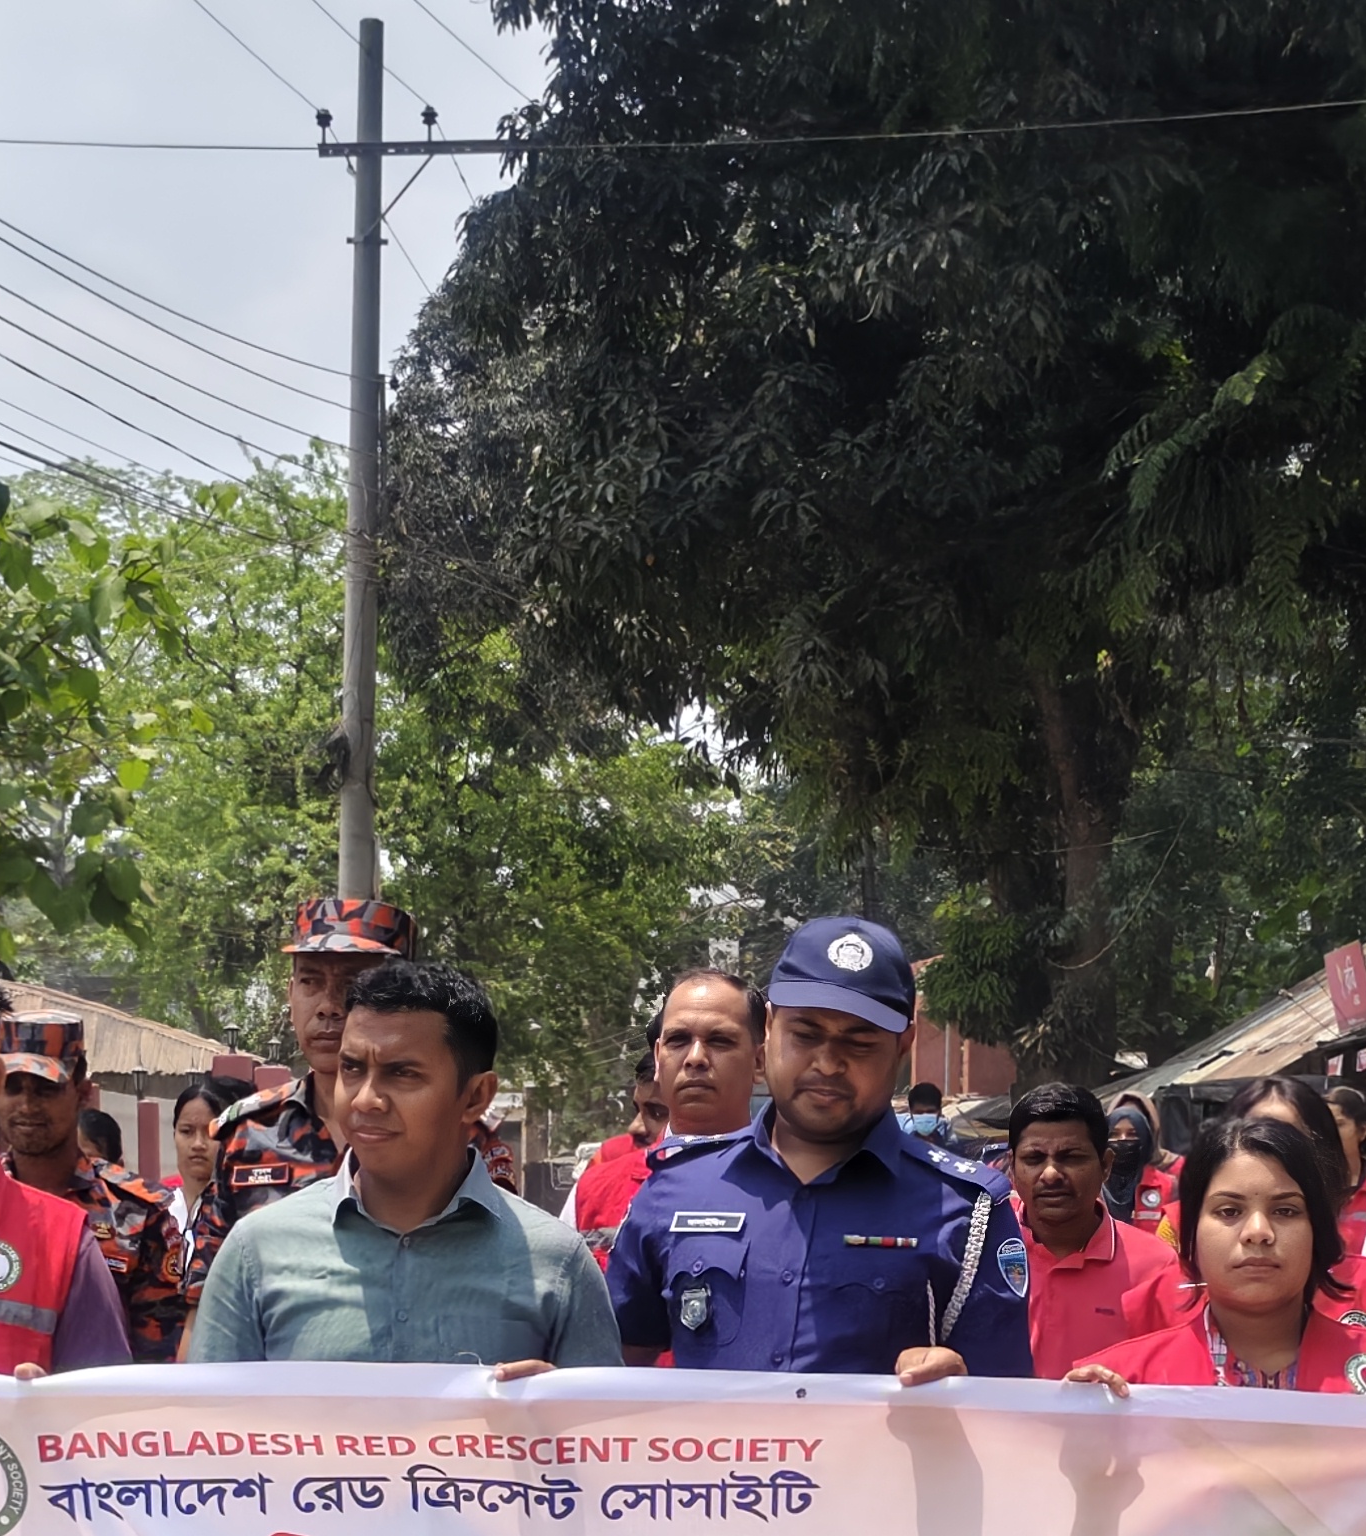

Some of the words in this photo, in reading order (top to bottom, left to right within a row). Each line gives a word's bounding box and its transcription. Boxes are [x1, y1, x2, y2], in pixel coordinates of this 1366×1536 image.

[37, 1431, 324, 1462] BANGLADESH
[336, 1434, 416, 1456] RED
[428, 1434, 639, 1465] CRESCENT
[647, 1436, 824, 1463] SOCIETY
[7, 1463, 24, 1515] SOCIETY
[40, 1473, 274, 1523] বাংলাদেশ
[293, 1475, 391, 1516] রেড
[402, 1463, 583, 1520] ক্রিসেন্ট
[601, 1469, 821, 1523] সোসাইটি
